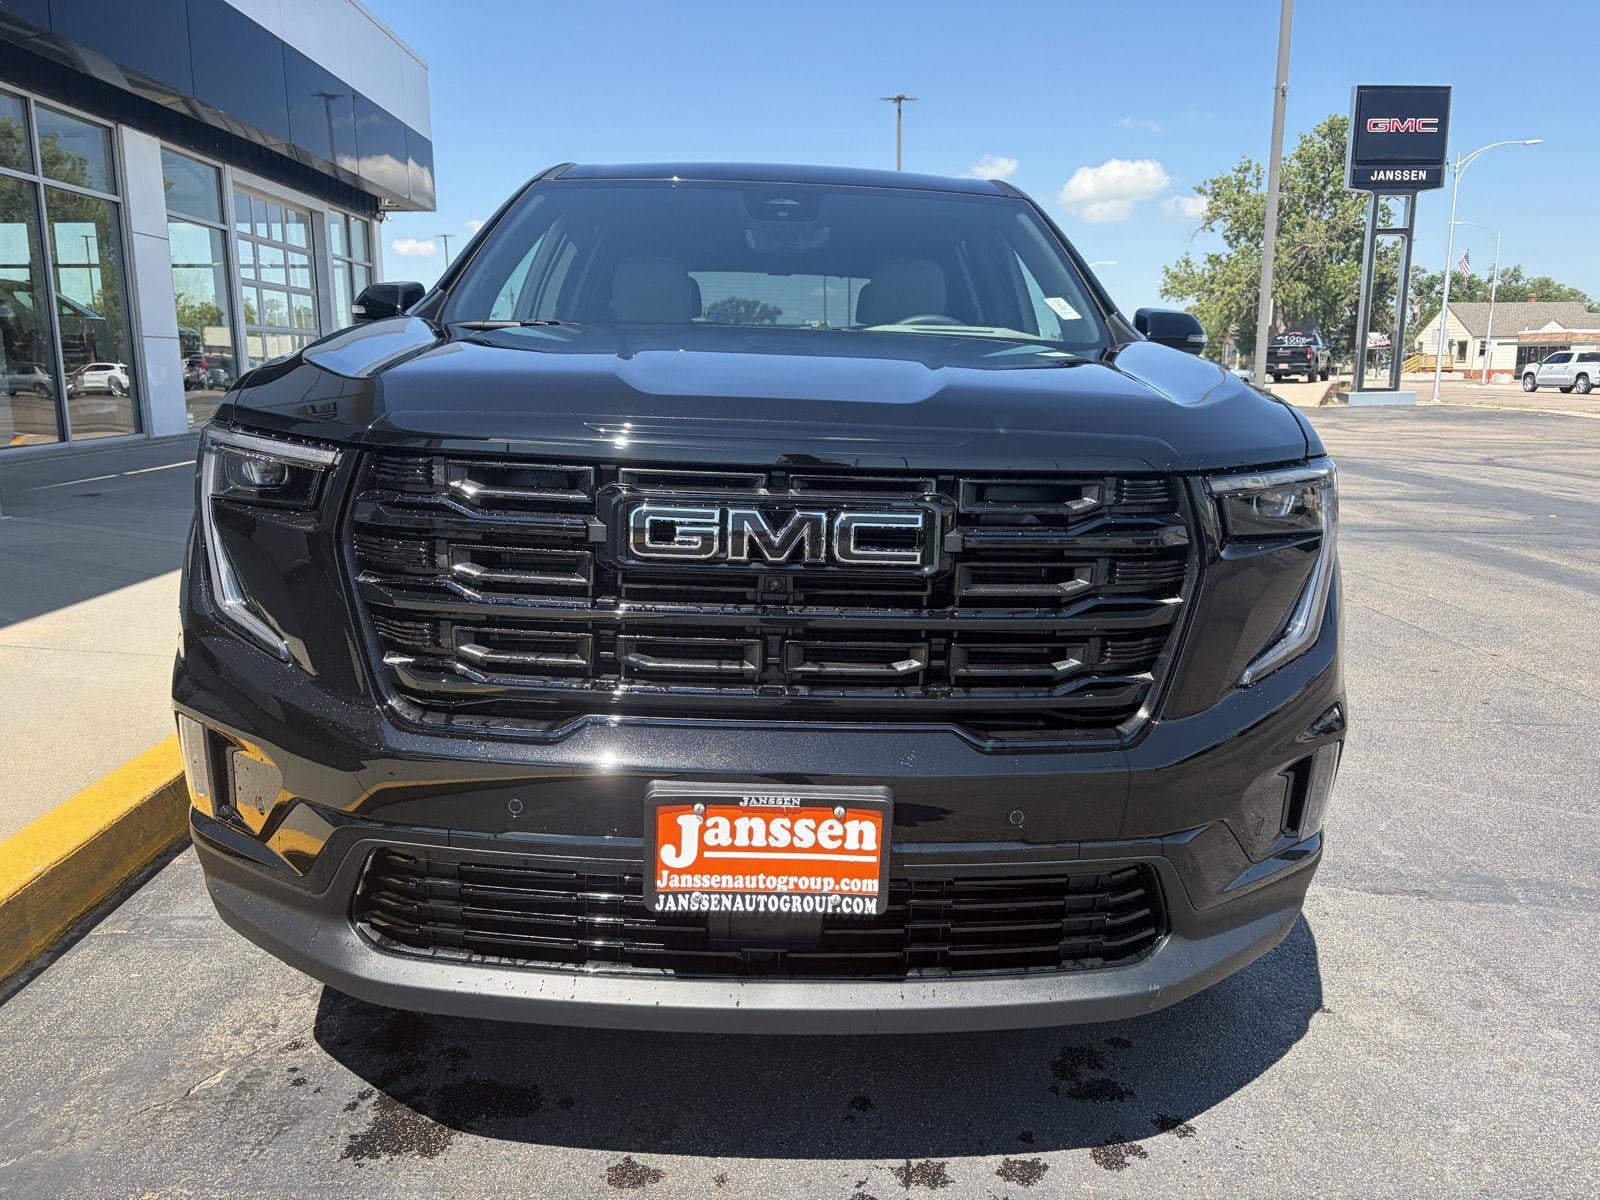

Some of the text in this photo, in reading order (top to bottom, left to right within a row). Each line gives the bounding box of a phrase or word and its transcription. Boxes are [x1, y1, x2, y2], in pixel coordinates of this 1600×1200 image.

[1367, 118, 1438, 132] GMC
[1370, 170, 1427, 180] JANSSEN
[629, 505, 923, 564] GMC
[739, 797, 800, 806] JANSSEN
[660, 814, 878, 868] Janssen
[656, 870, 879, 892] Janssenautogroup.com
